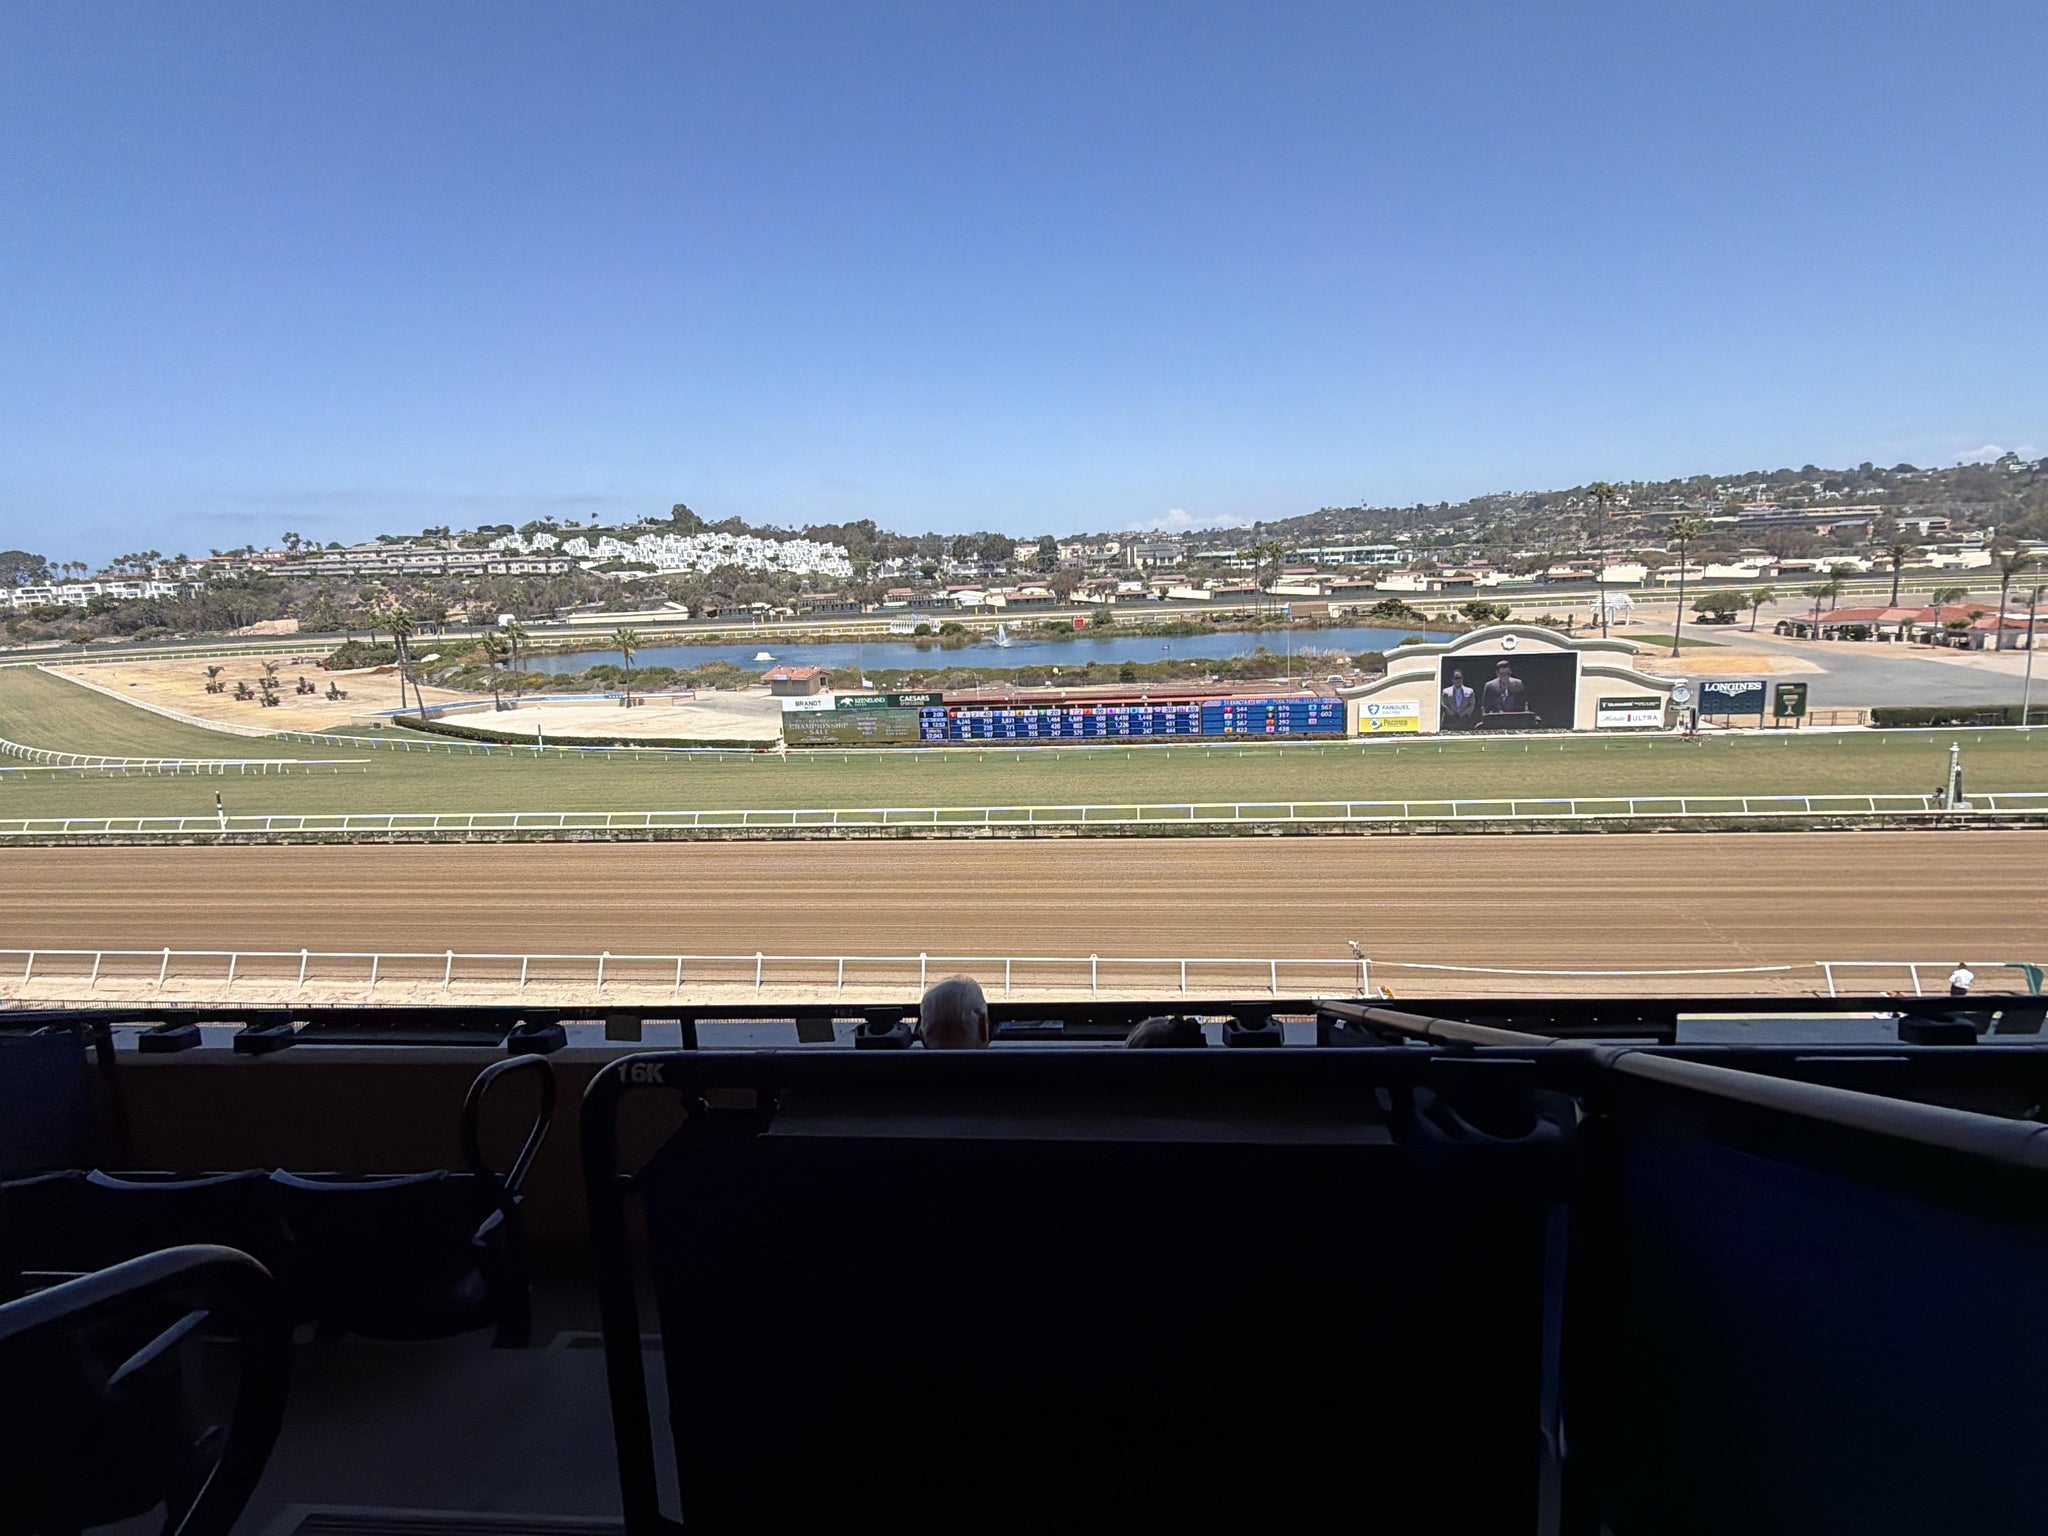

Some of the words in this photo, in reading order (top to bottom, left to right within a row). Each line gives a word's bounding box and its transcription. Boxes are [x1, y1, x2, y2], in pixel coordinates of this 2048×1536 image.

[1704, 682, 1762, 691] LONGINES
[1633, 714, 1658, 722] ULTRA
[618, 1062, 664, 1083] 16K
